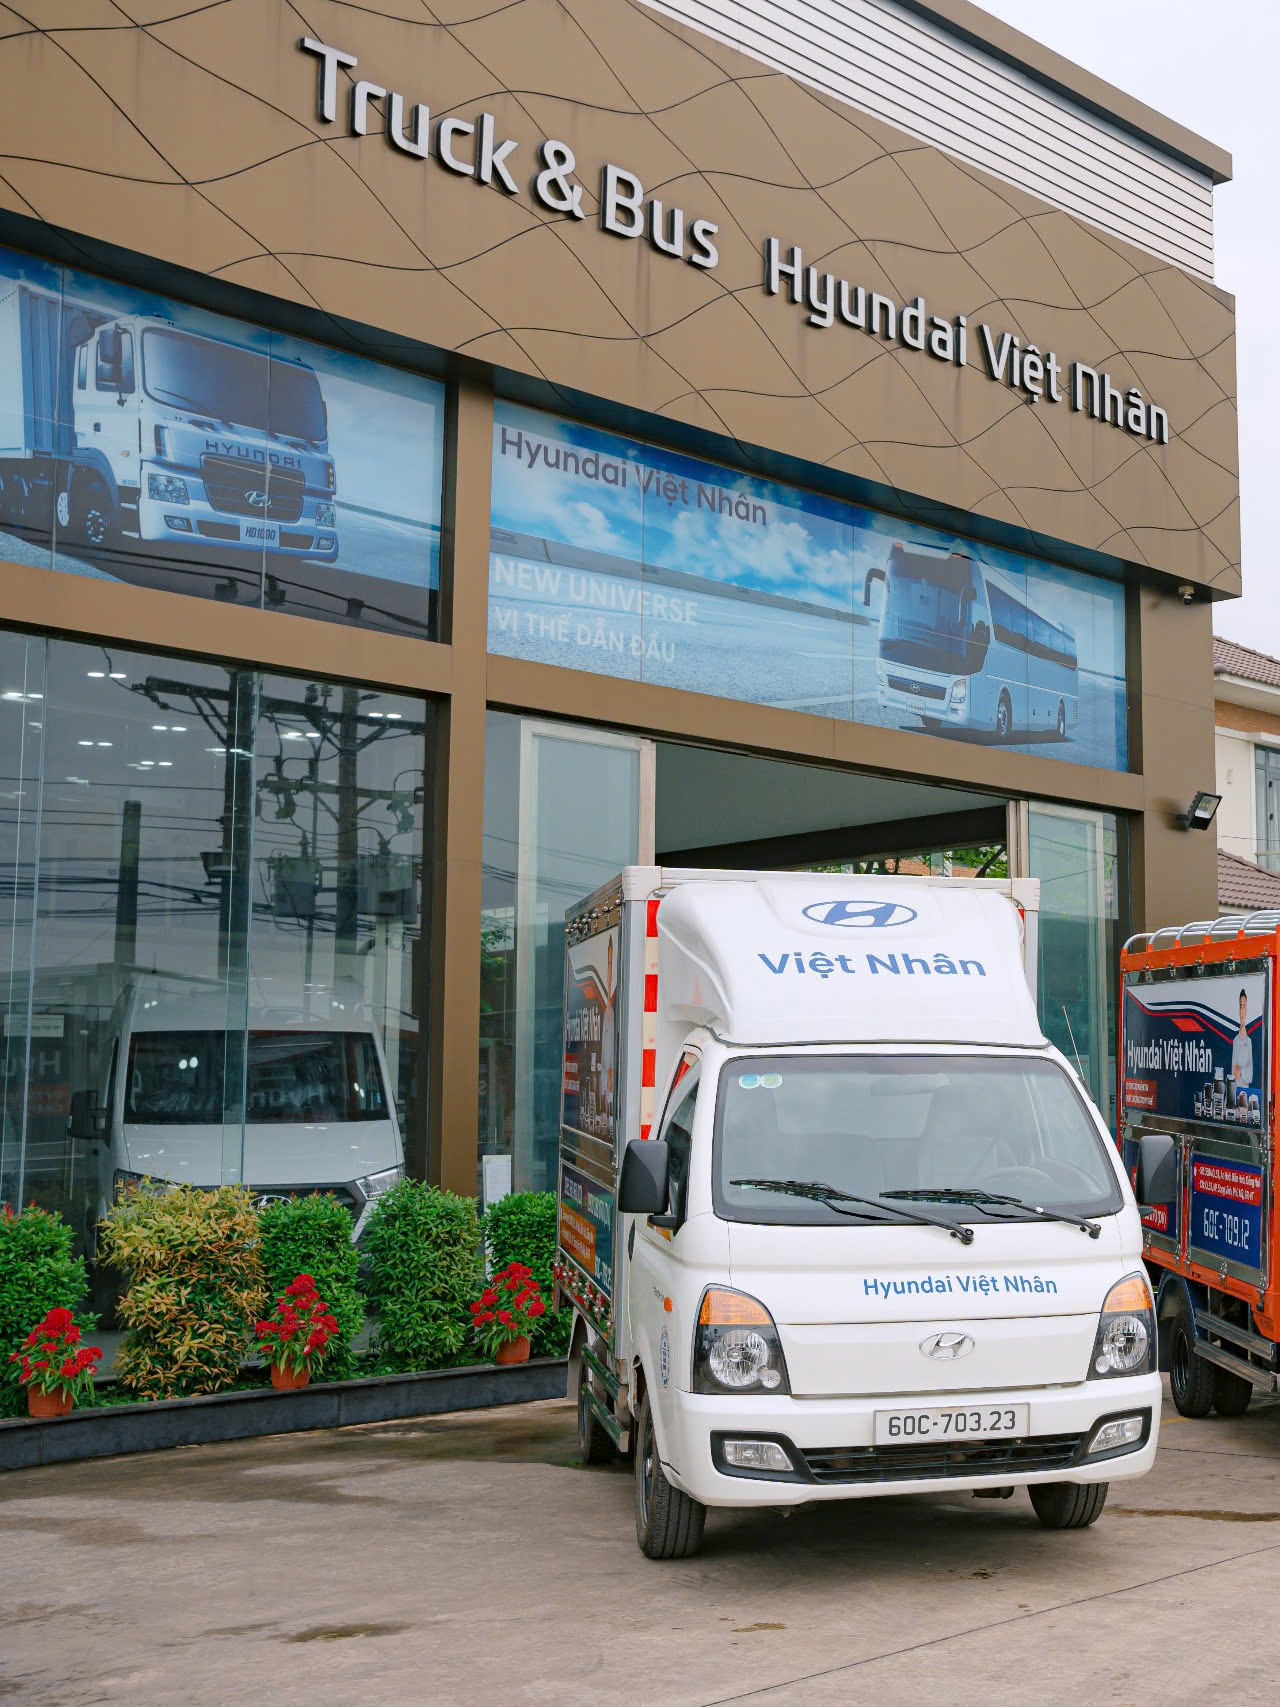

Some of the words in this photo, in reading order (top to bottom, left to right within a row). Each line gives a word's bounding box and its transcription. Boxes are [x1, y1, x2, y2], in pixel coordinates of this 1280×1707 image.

[298, 36, 519, 194] Truck
[533, 139, 585, 220] &
[600, 164, 718, 268] Bus
[764, 237, 966, 367] Hyundai
[978, 323, 1062, 404] Việt
[1070, 361, 1169, 444] Nhân
[205, 439, 301, 468] HYUNDAI
[501, 427, 626, 487] Hyundai
[635, 465, 689, 507] Việt
[697, 484, 766, 526] Nhân
[495, 558, 558, 595] NEW
[569, 575, 698, 624] UNIVERSE
[495, 606, 520, 639] VỊ
[525, 611, 569, 643] THẾ
[577, 616, 624, 652] DẪN
[758, 952, 855, 978] Việt
[865, 952, 986, 976] Nhân
[1127, 1039, 1162, 1074] Hyundai
[1164, 1038, 1183, 1077] Việt
[1184, 1038, 1213, 1073] Nhân
[863, 1276, 951, 1299] Hyundai
[956, 1275, 999, 1296] Việt
[1004, 1275, 1058, 1294] Nhân
[888, 1410, 1016, 1437] 60C-703.23
